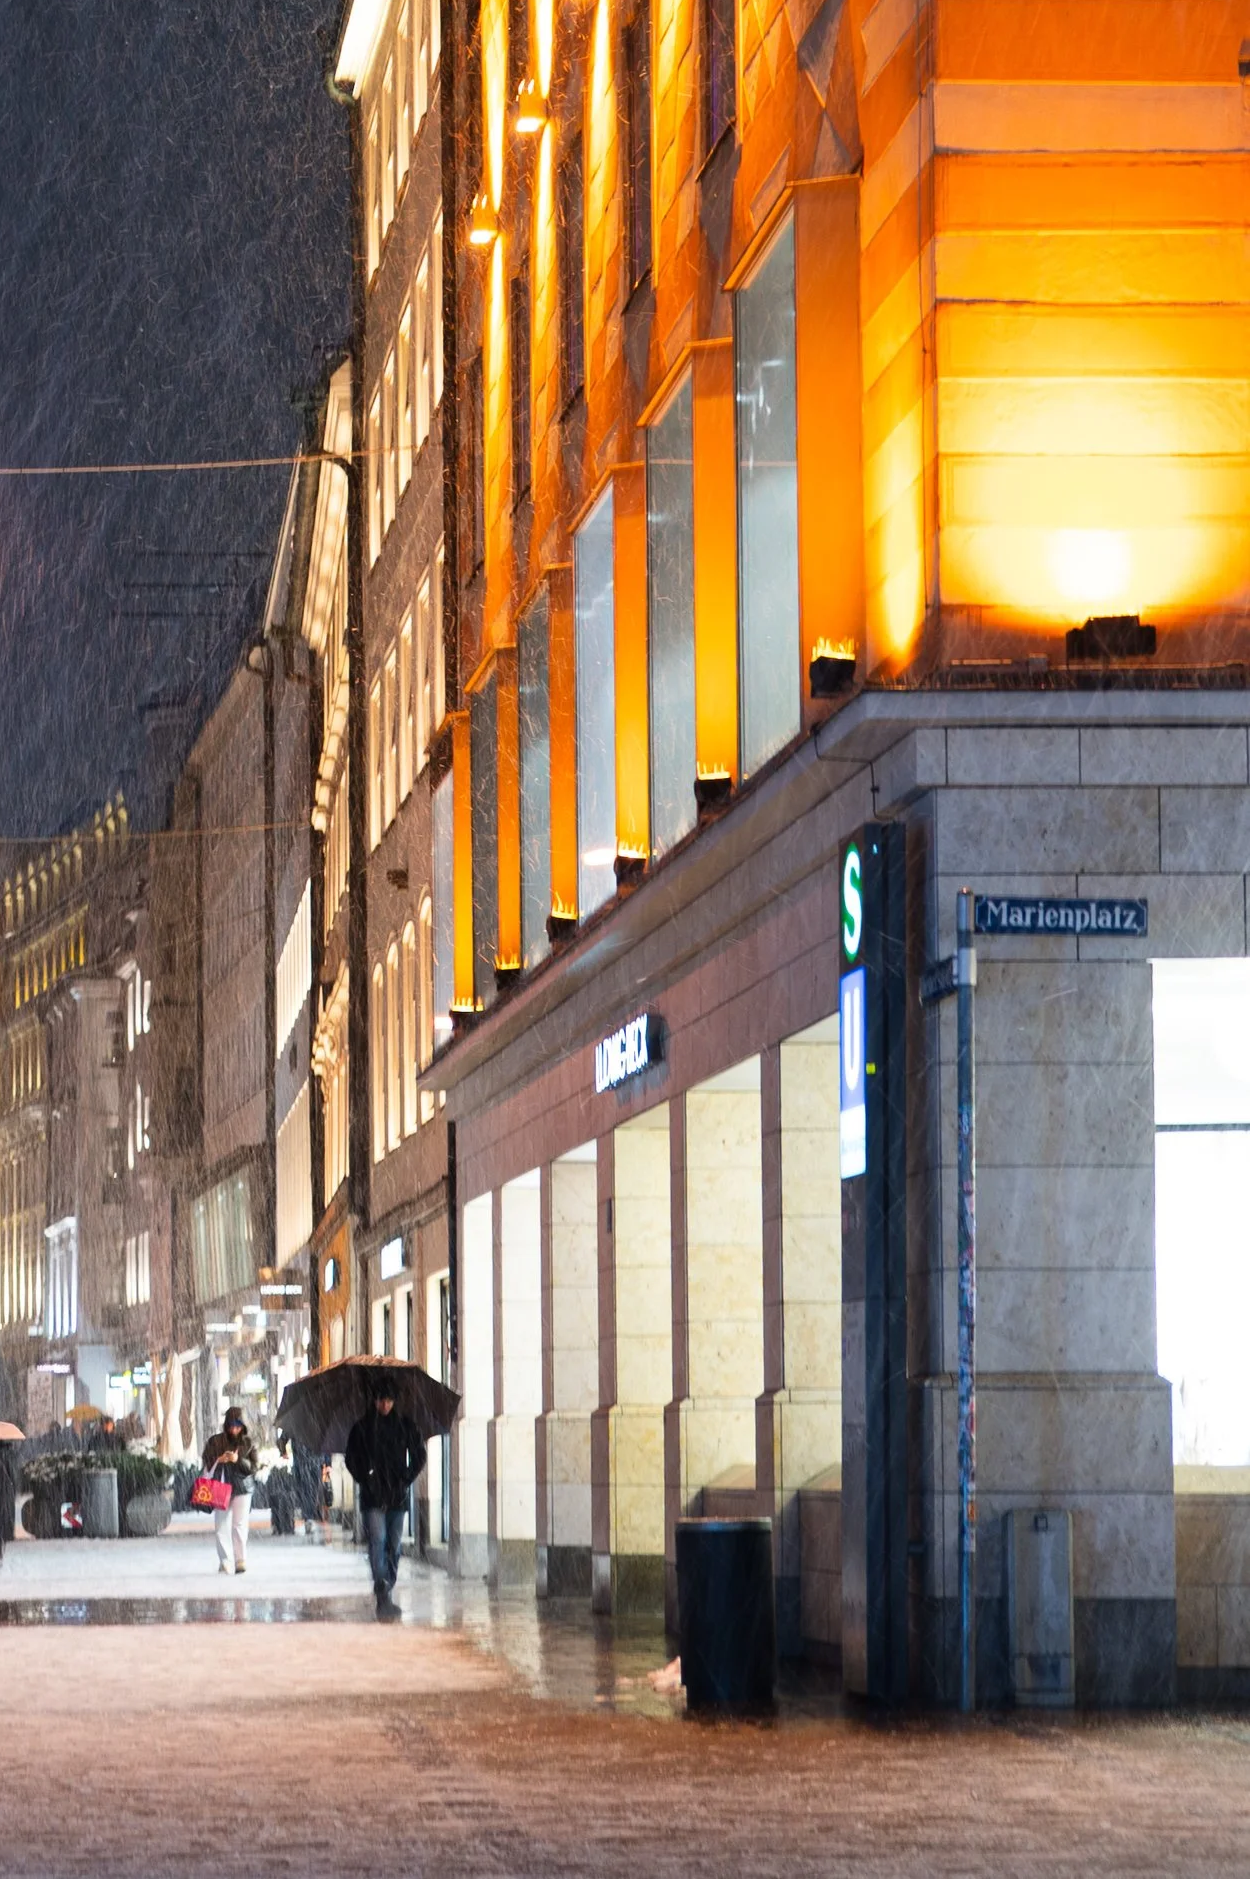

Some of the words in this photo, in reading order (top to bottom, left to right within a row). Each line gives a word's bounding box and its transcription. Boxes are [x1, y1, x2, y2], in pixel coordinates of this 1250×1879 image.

[843, 850, 863, 956] S
[987, 900, 1138, 933] Marienplatz
[843, 986, 861, 1091] U
